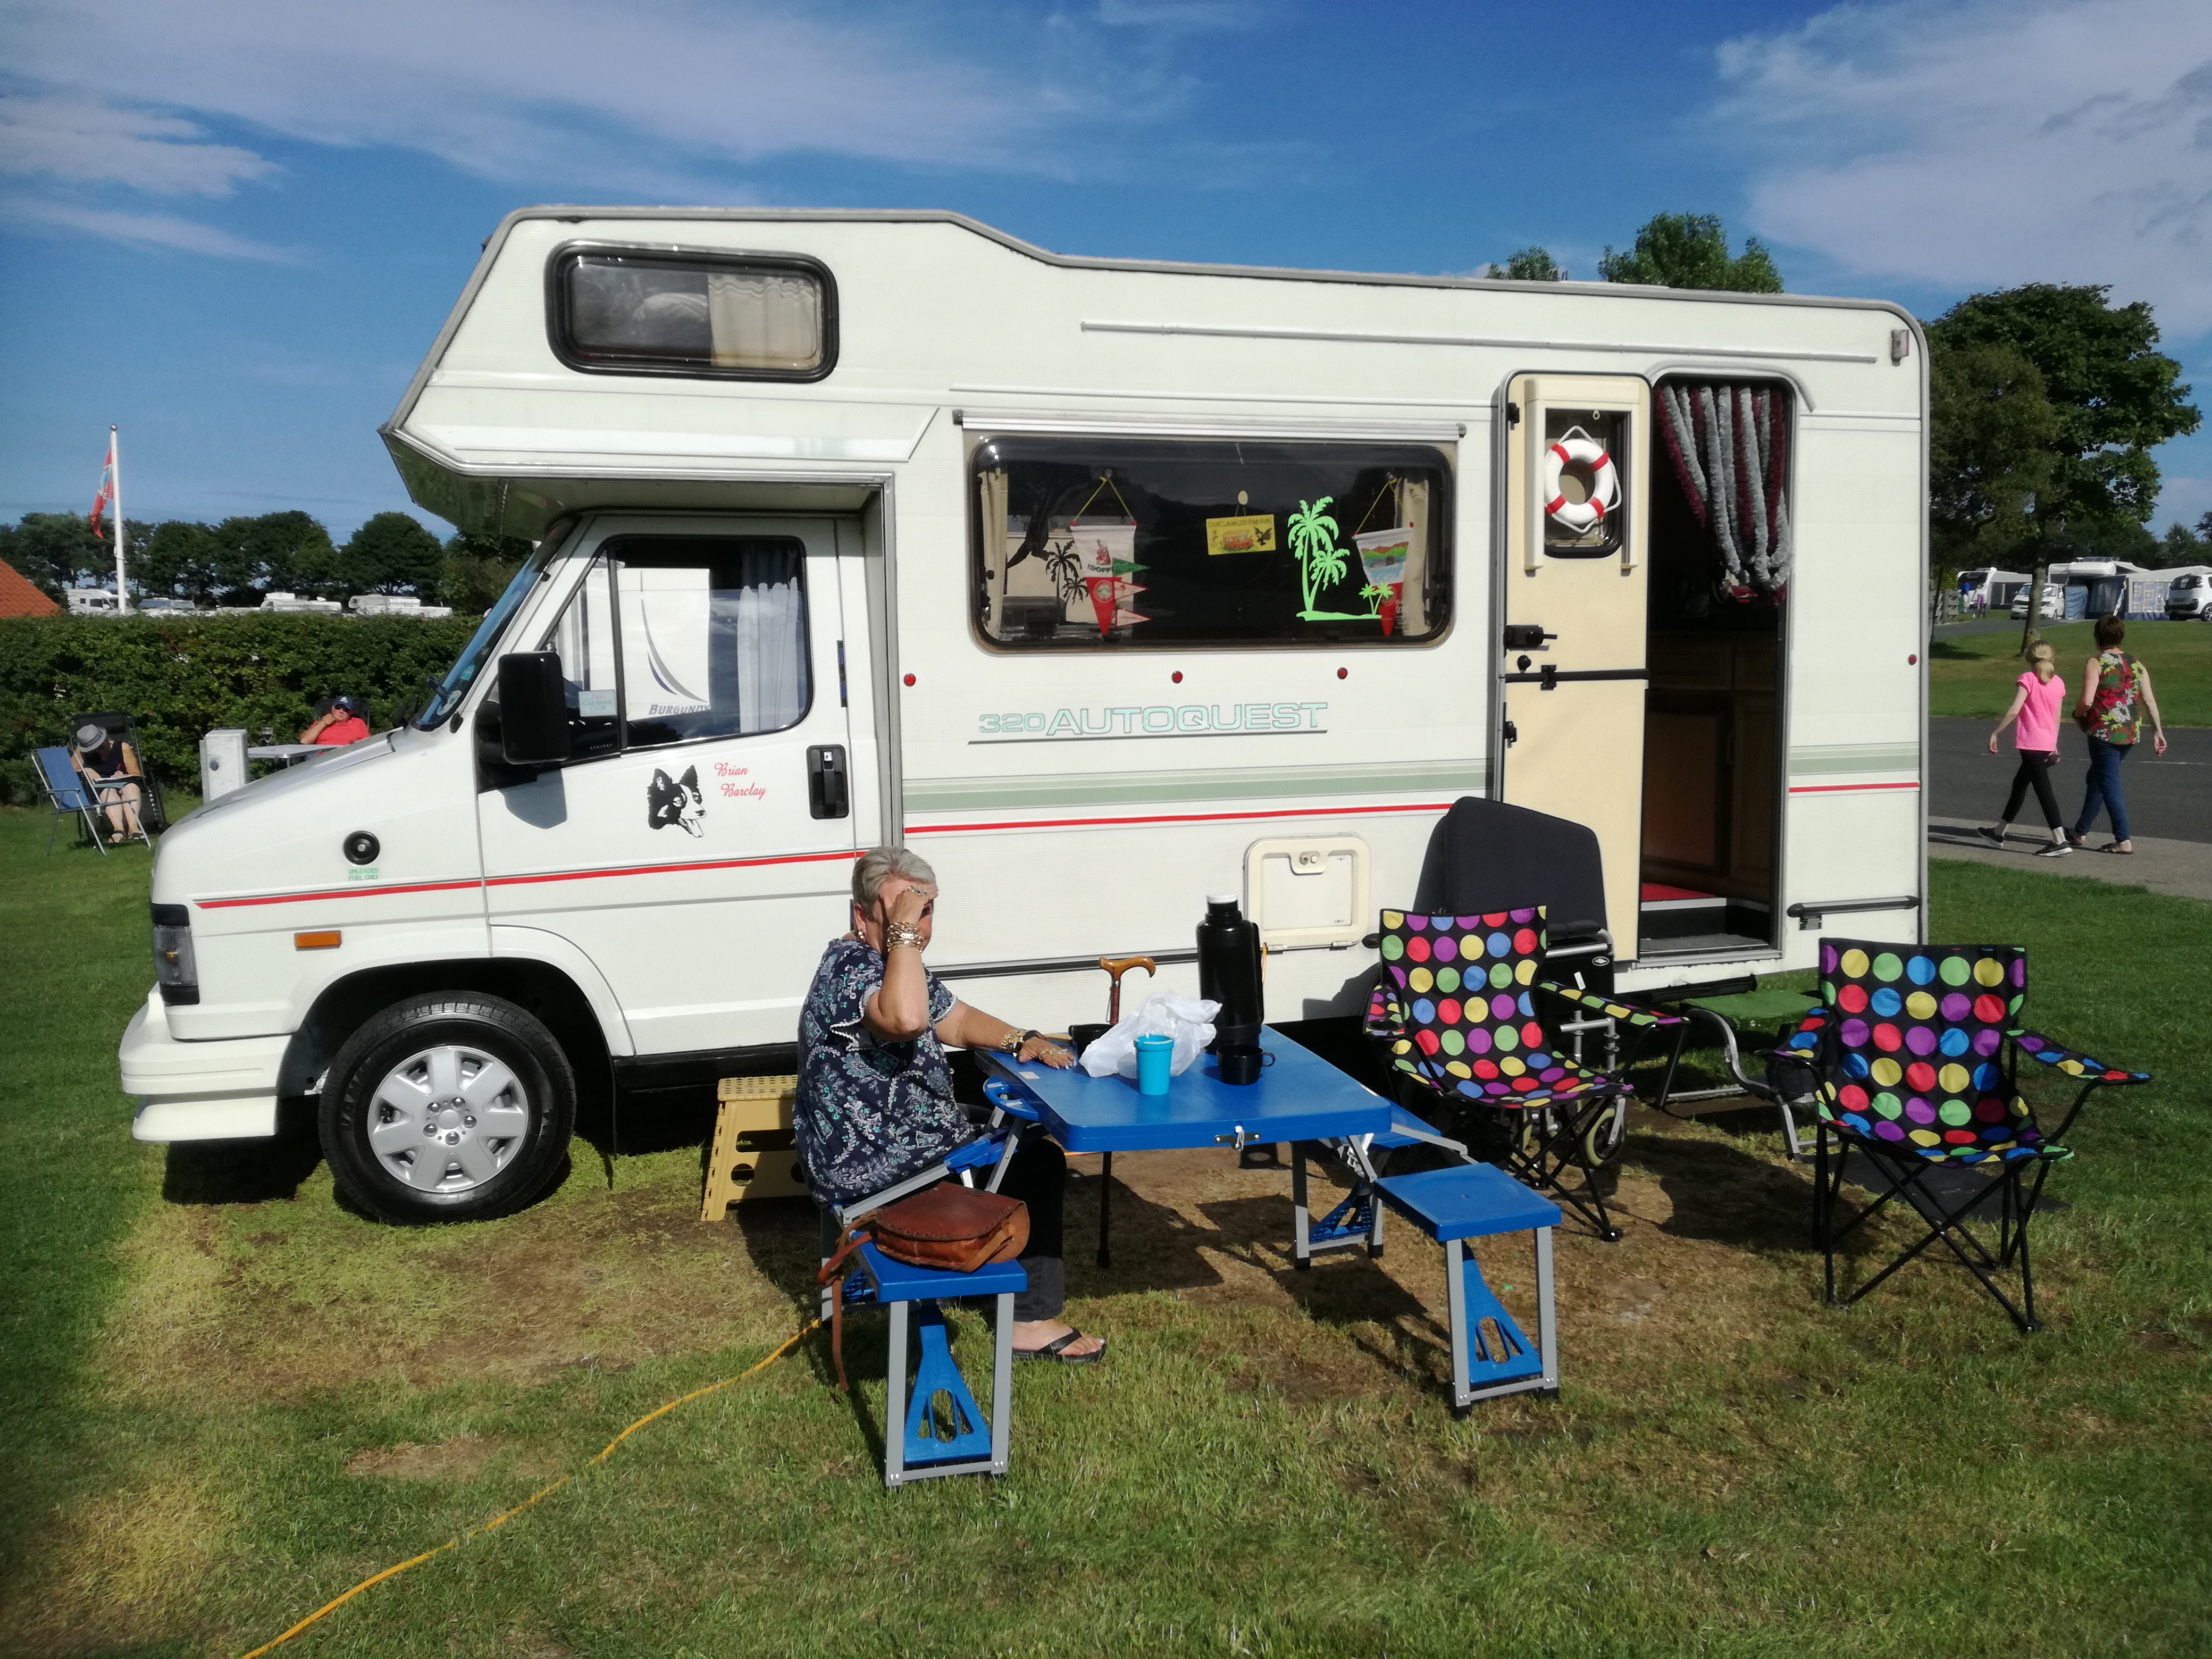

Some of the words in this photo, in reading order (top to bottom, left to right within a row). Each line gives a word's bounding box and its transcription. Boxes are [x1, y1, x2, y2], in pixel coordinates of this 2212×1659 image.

[979, 713, 1046, 733] 320
[1045, 702, 1328, 735] AUTOQUEST
[714, 763, 749, 777] Brian
[720, 782, 766, 800] Barclay
